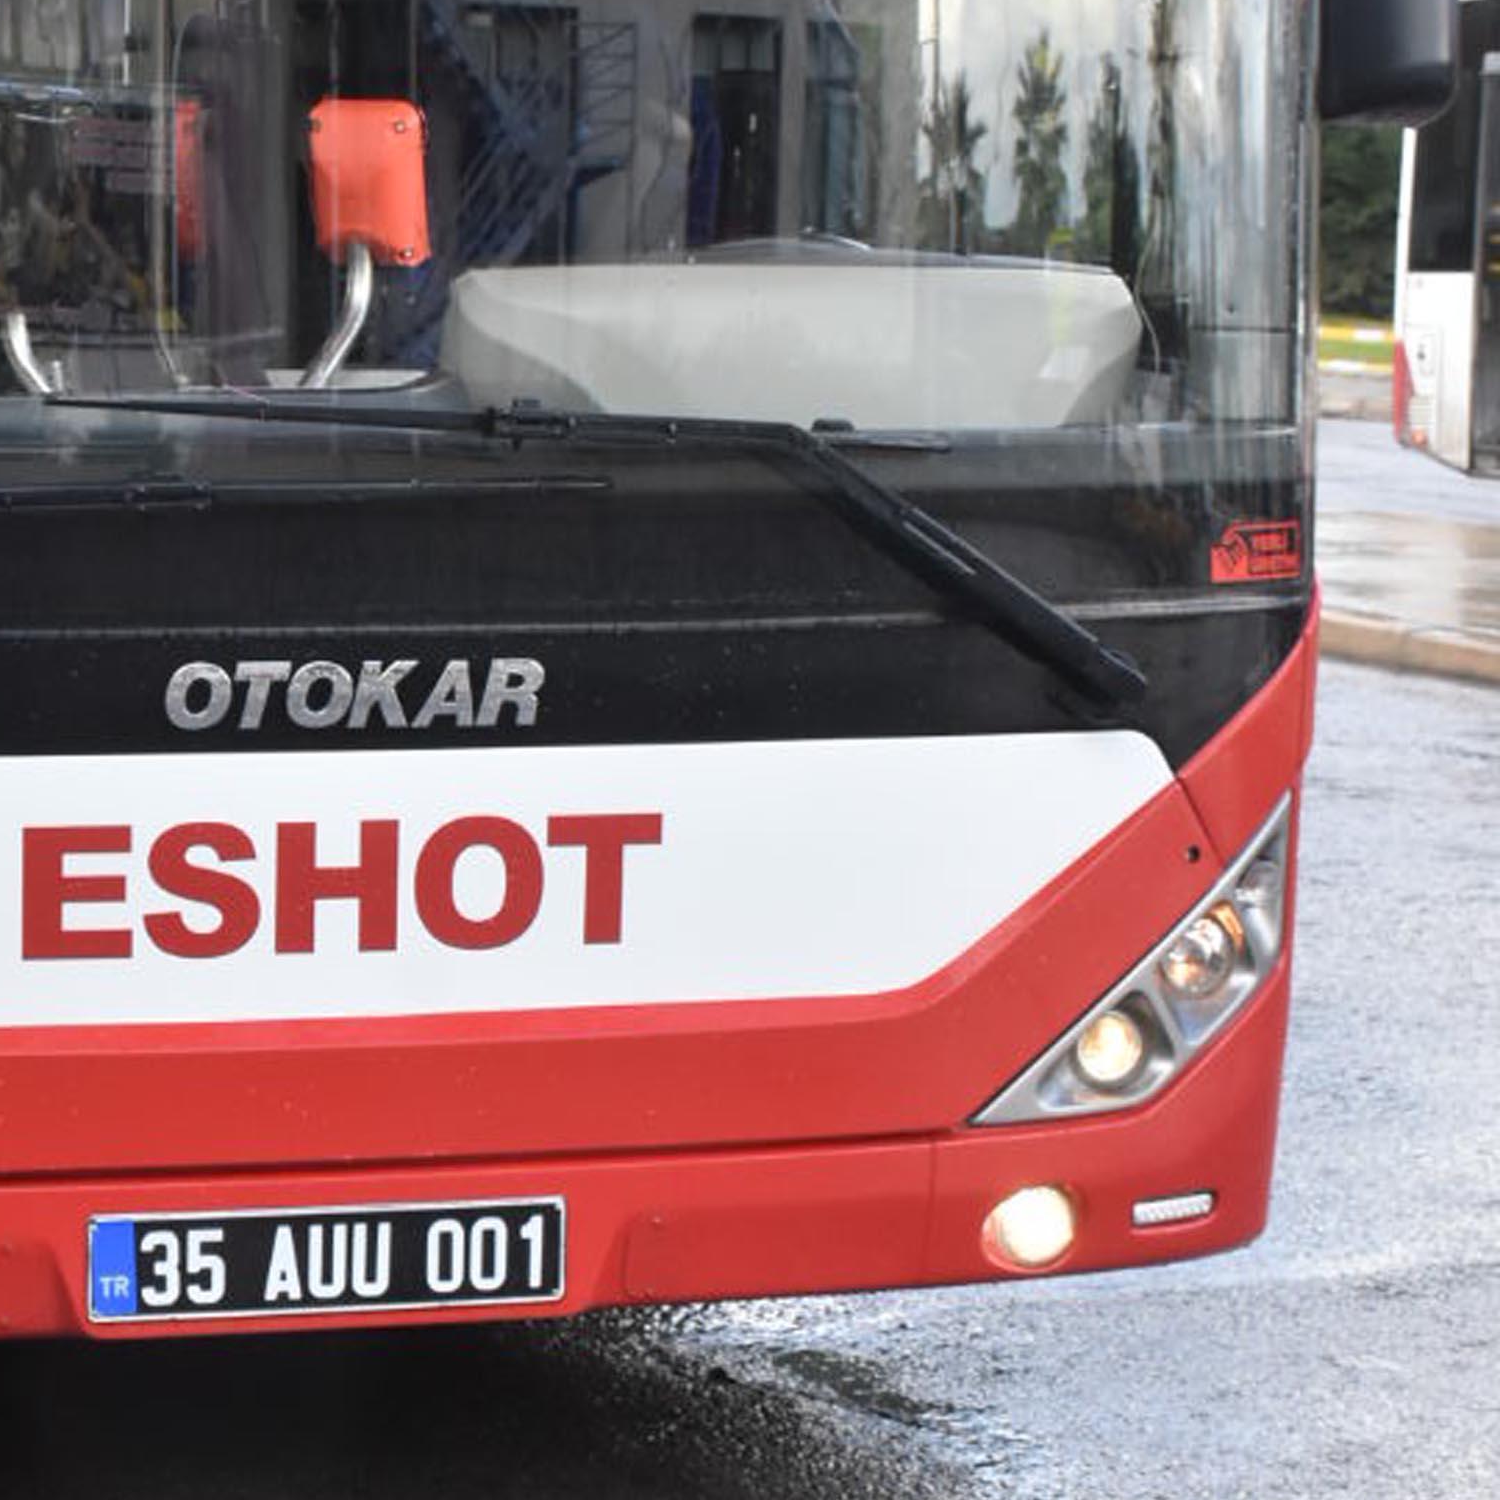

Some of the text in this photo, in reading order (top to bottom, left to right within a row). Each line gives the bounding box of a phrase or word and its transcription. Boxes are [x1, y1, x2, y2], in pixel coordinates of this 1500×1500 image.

[164, 657, 547, 731] OTOKAR
[21, 812, 664, 962] ESHOT
[100, 1276, 129, 1298] TR
[139, 1214, 546, 1308] 35 AUU 001
